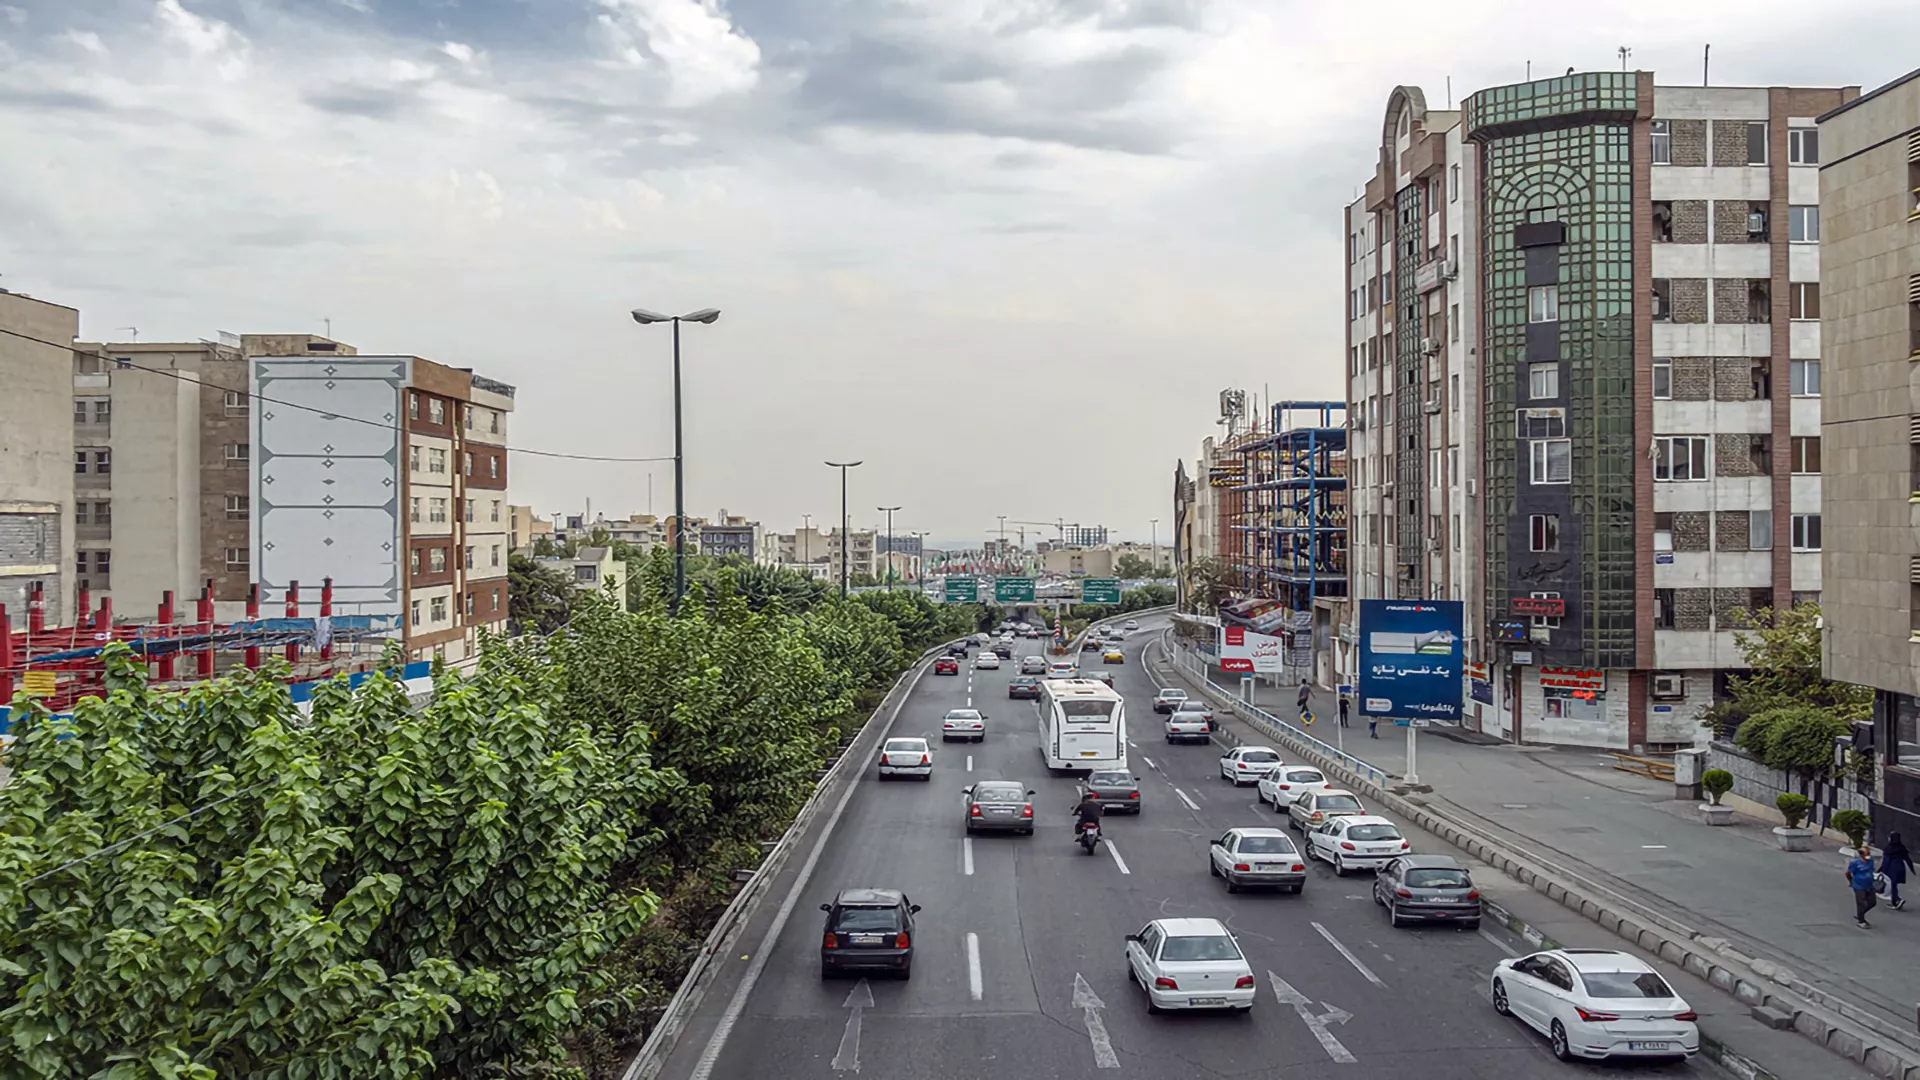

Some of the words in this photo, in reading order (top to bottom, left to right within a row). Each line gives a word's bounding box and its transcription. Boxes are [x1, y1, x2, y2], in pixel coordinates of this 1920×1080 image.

[1372, 664, 1396, 675] تازه
[1397, 665, 1430, 676] نفس
[1431, 665, 1450, 678] یک
[1540, 678, 1603, 689] PHARMACY
